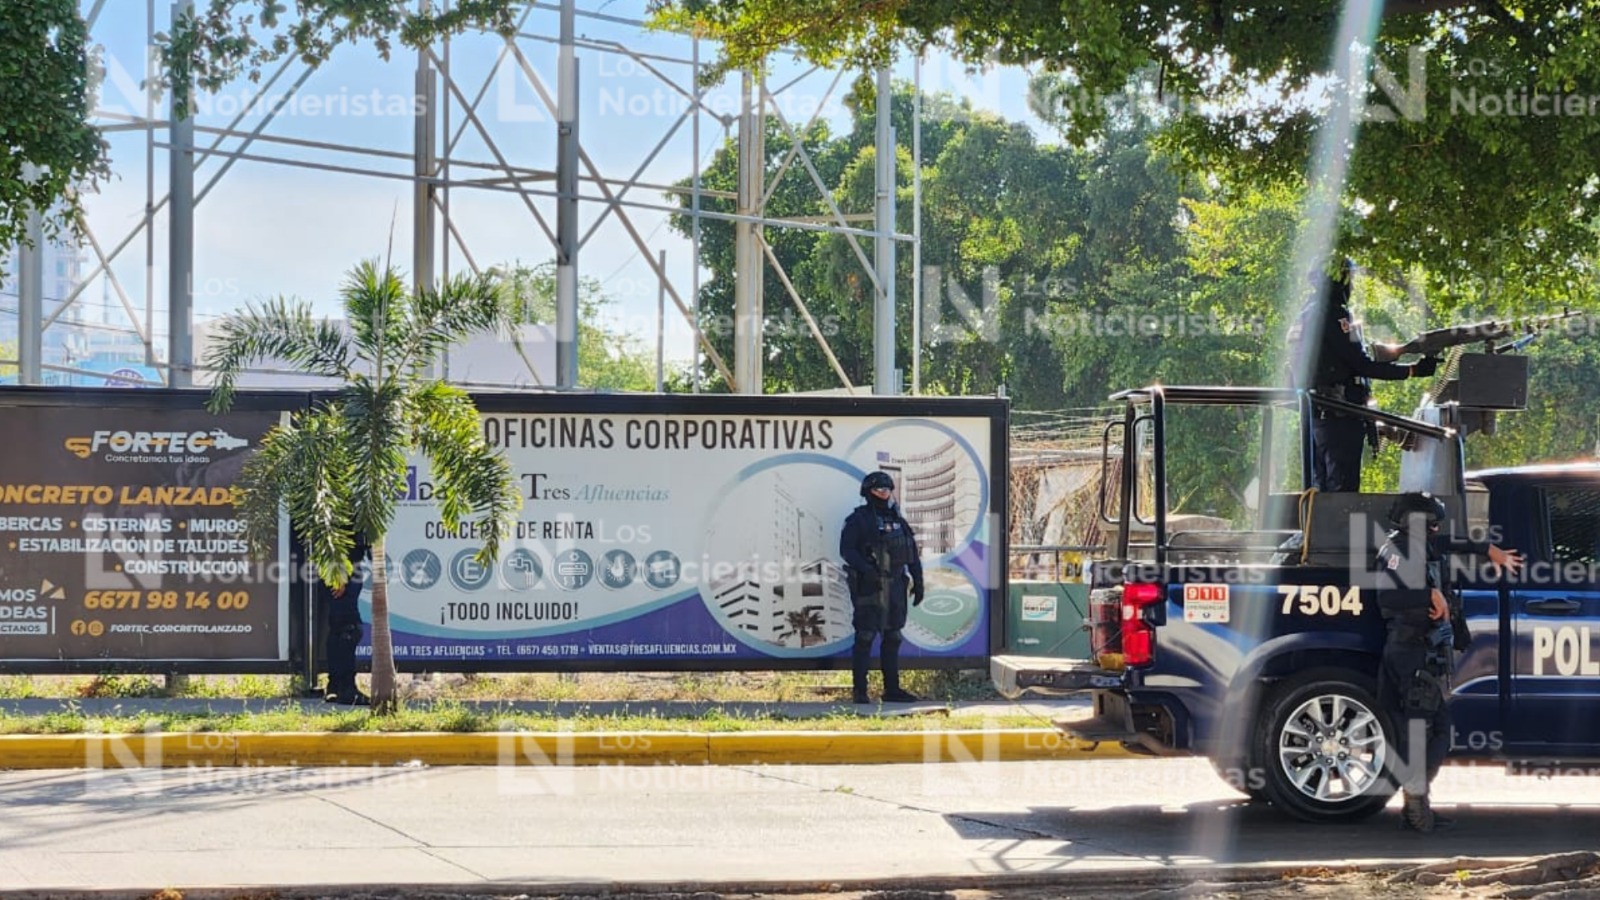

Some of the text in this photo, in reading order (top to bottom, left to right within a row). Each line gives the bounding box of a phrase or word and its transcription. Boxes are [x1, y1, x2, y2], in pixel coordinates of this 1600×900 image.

[91, 431, 208, 454] FORTEC
[484, 417, 833, 450] OFICINAS CORPORATIVAS
[105, 454, 210, 464] Concretamos tus ideas
[0, 484, 112, 505] NCRETO
[521, 473, 670, 503] Tres Afluencias
[82, 519, 172, 533] CISTERNAS
[191, 519, 248, 533] MUROS
[425, 521, 594, 539] CONCEP DE RENTA
[19, 536, 249, 554] ESTABILIZACIÓN DE TALUDES
[124, 559, 249, 574] CONSTRUCCIÓN
[84, 591, 249, 609] 6671 98 14 00
[1188, 587, 1224, 600] 911
[1278, 586, 1363, 616] 7504
[440, 602, 579, 624] ¡TODO INCLUIDO!
[410, 645, 432, 656] TRES
[433, 645, 485, 656] AFLUENCIAS
[541, 645, 559, 656] 450
[1533, 626, 1600, 676] POL
